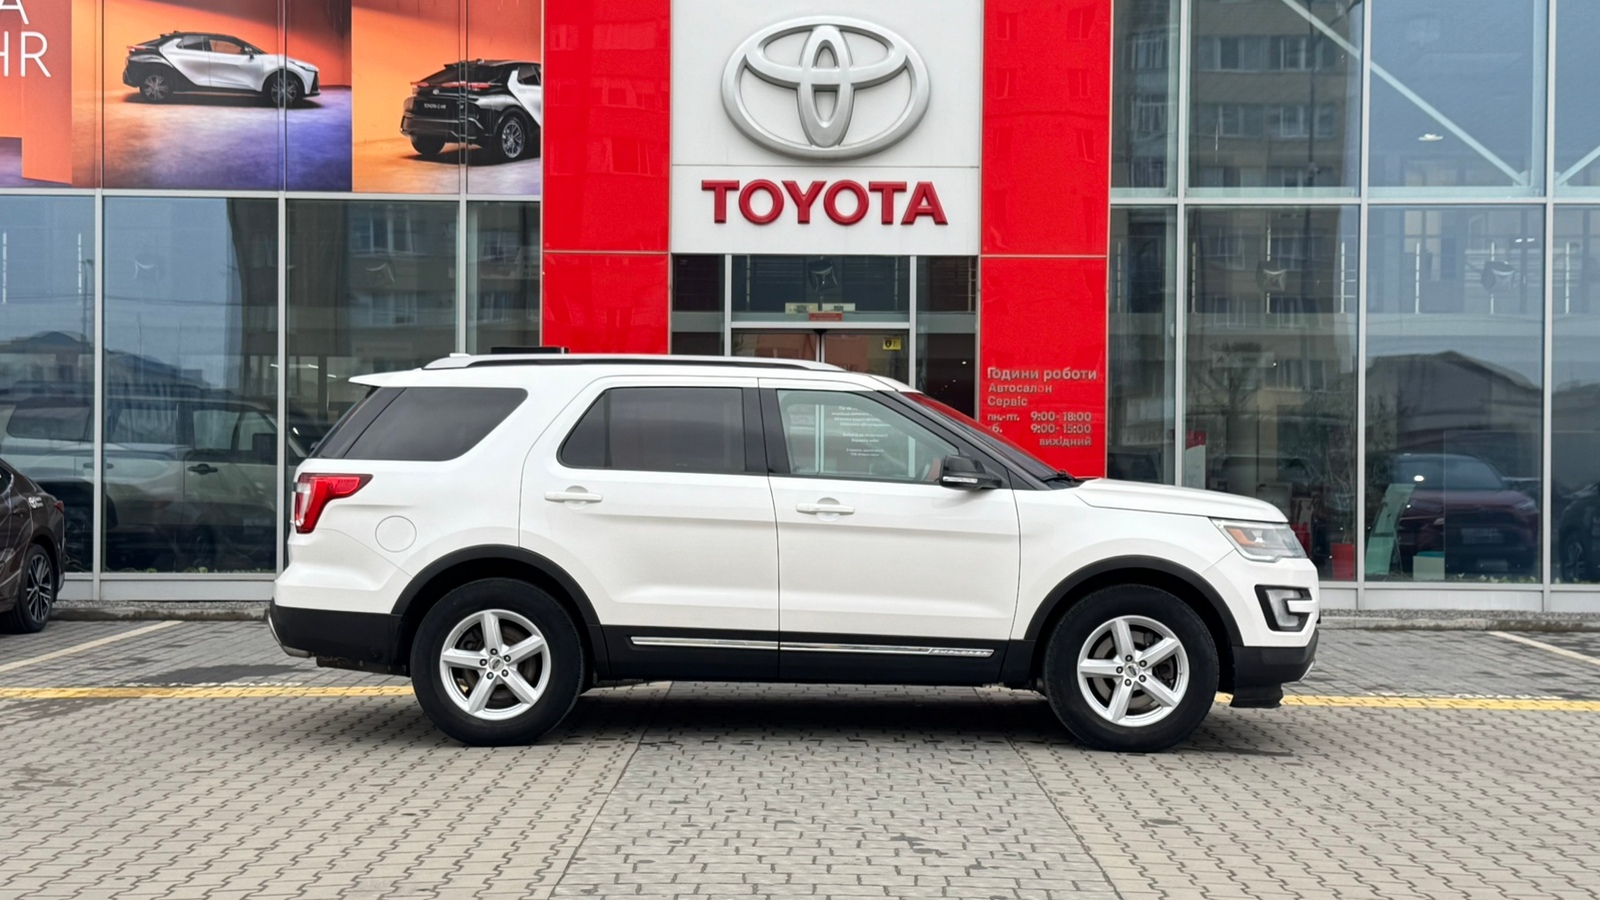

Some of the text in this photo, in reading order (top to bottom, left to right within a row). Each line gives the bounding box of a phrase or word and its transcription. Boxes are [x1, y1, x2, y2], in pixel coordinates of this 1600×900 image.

[701, 178, 948, 226] TOYOTA
[987, 367, 1097, 382] Години роботи
[988, 383, 1052, 393] Автосалон
[987, 396, 1028, 408] Сервіс
[1062, 411, 1092, 422] 18:00
[1062, 423, 1092, 434] 15:00
[1039, 436, 1092, 447] вихідний
